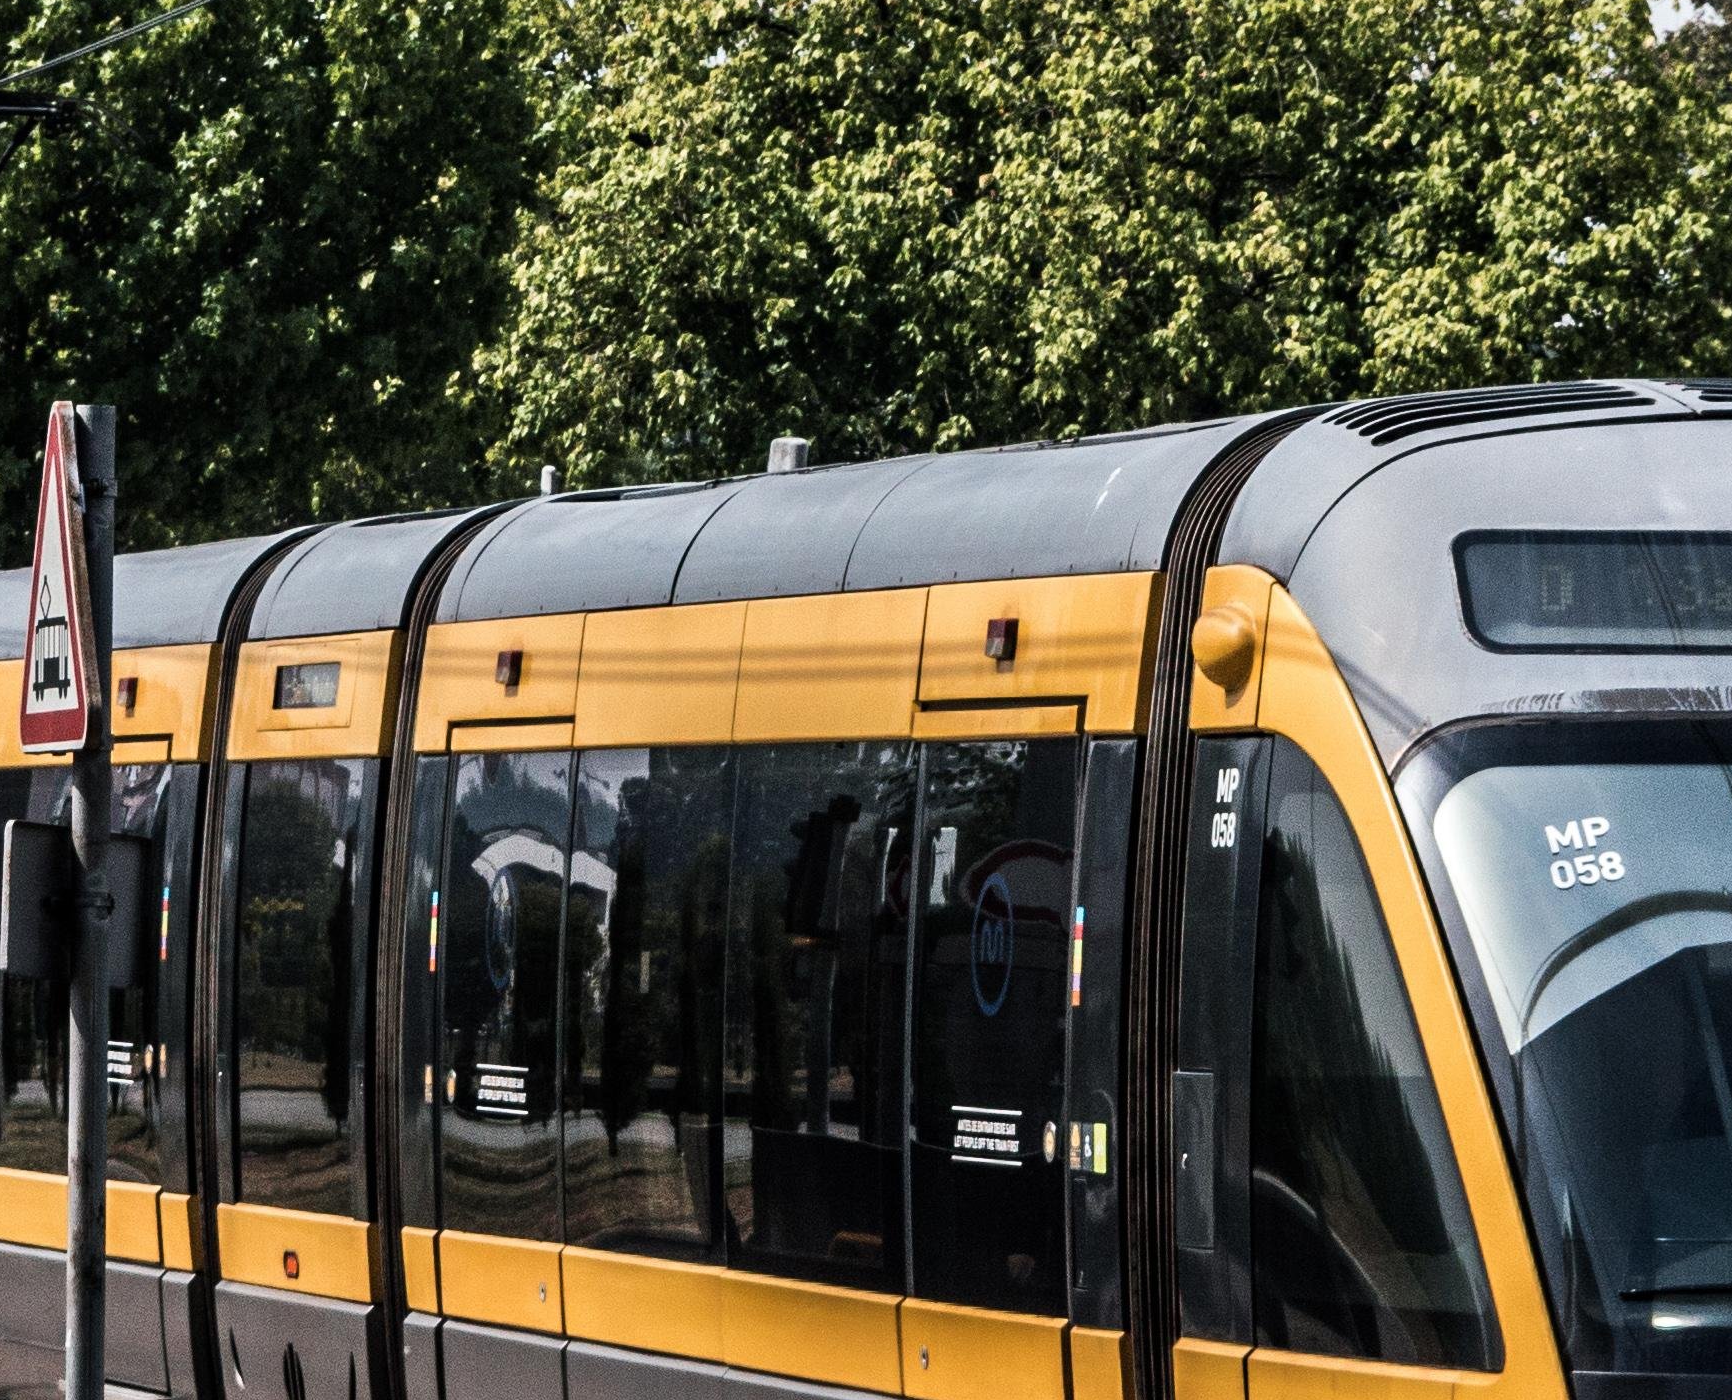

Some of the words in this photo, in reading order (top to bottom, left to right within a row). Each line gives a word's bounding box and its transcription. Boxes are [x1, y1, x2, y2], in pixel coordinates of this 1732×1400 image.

[1216, 768, 1240, 803] MP
[1211, 812, 1237, 847] 058
[1545, 816, 1610, 853] MP
[1550, 850, 1625, 889] 058
